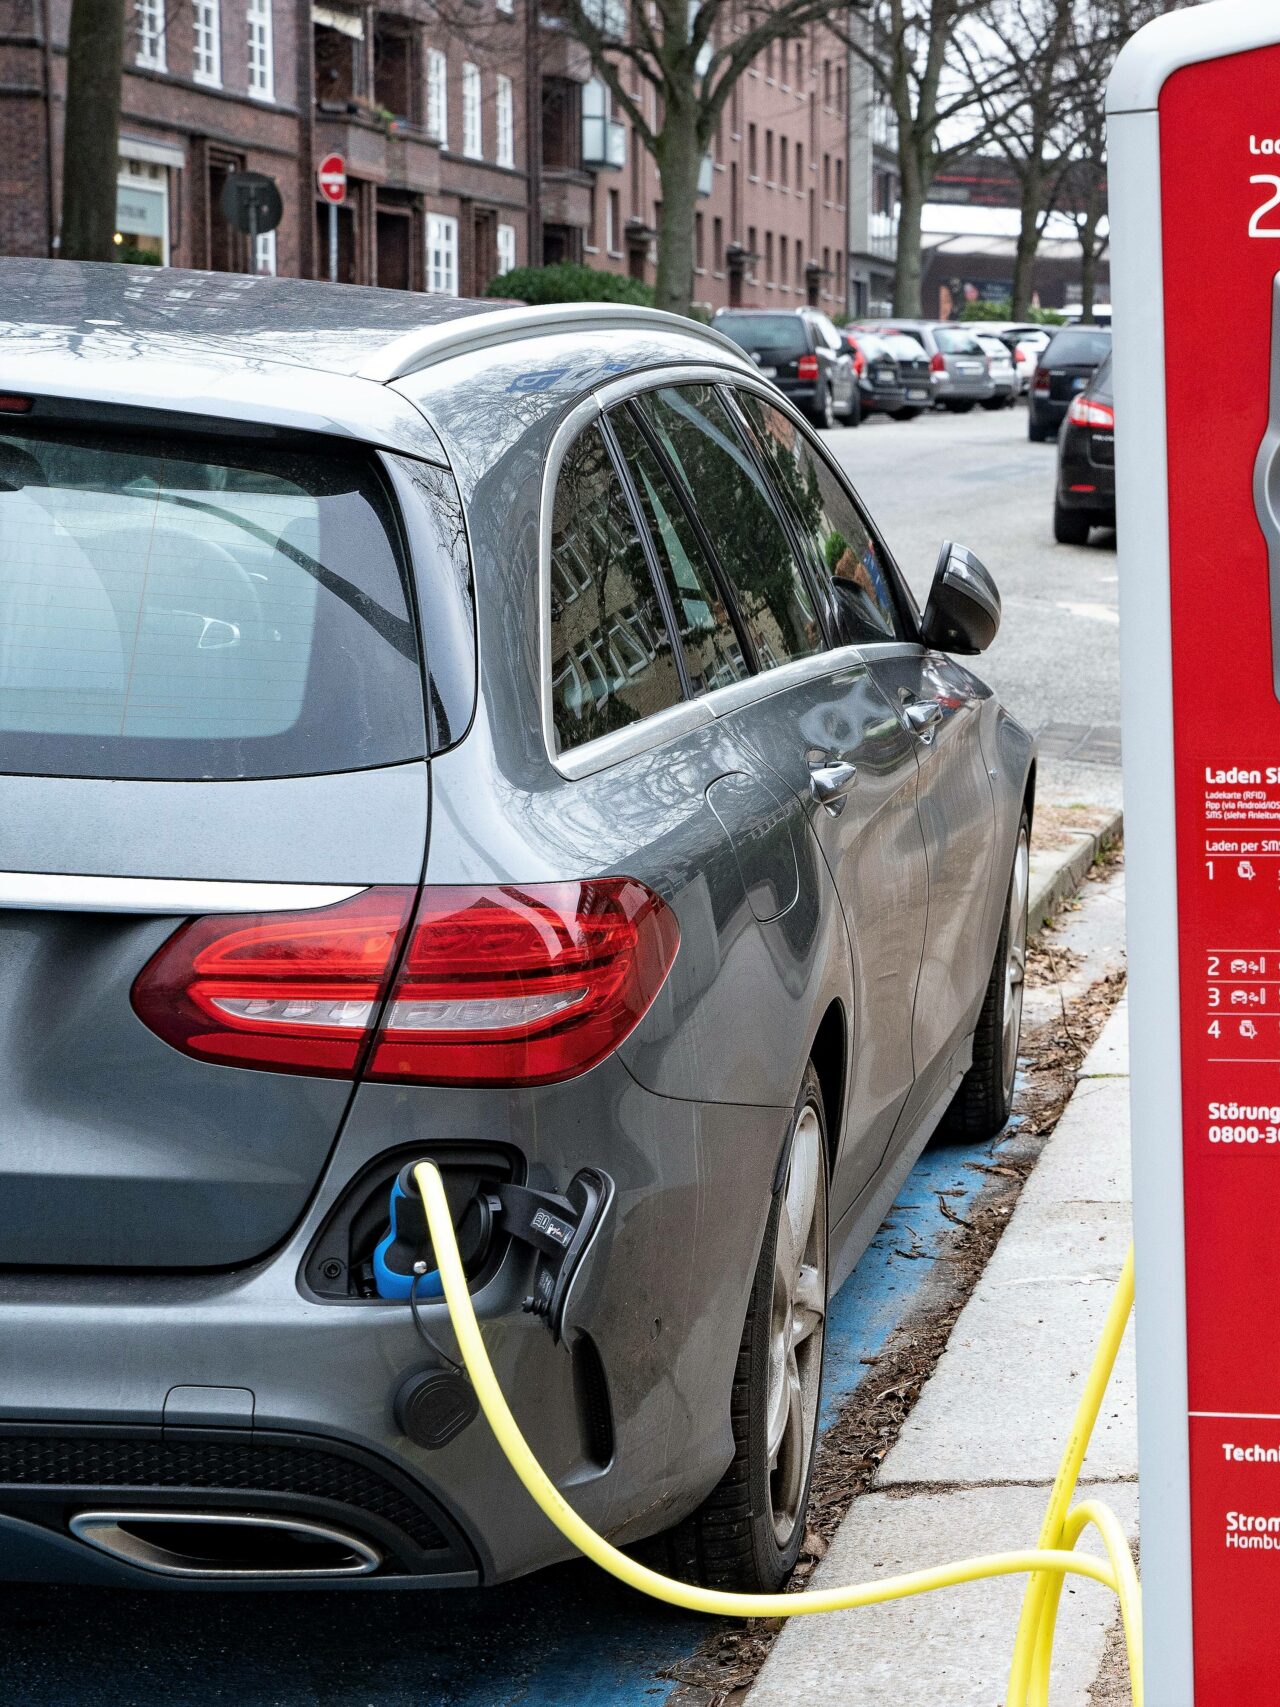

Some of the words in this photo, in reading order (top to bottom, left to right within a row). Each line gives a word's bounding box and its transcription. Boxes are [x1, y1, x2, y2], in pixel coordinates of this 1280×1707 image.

[1206, 767, 1261, 784] Laden
[1205, 791, 1242, 800] Ladekarte
[1242, 792, 1266, 800] (RFID)
[1206, 801, 1220, 810] App
[1222, 801, 1236, 810] (via
[1206, 811, 1222, 819] SMS
[1224, 811, 1246, 820] (siehe
[1206, 841, 1238, 851] Laden
[1240, 843, 1258, 853] per
[1206, 861, 1213, 879] 1
[1208, 957, 1219, 975] 2
[1208, 988, 1220, 1006] 3
[1208, 1020, 1221, 1038] 4
